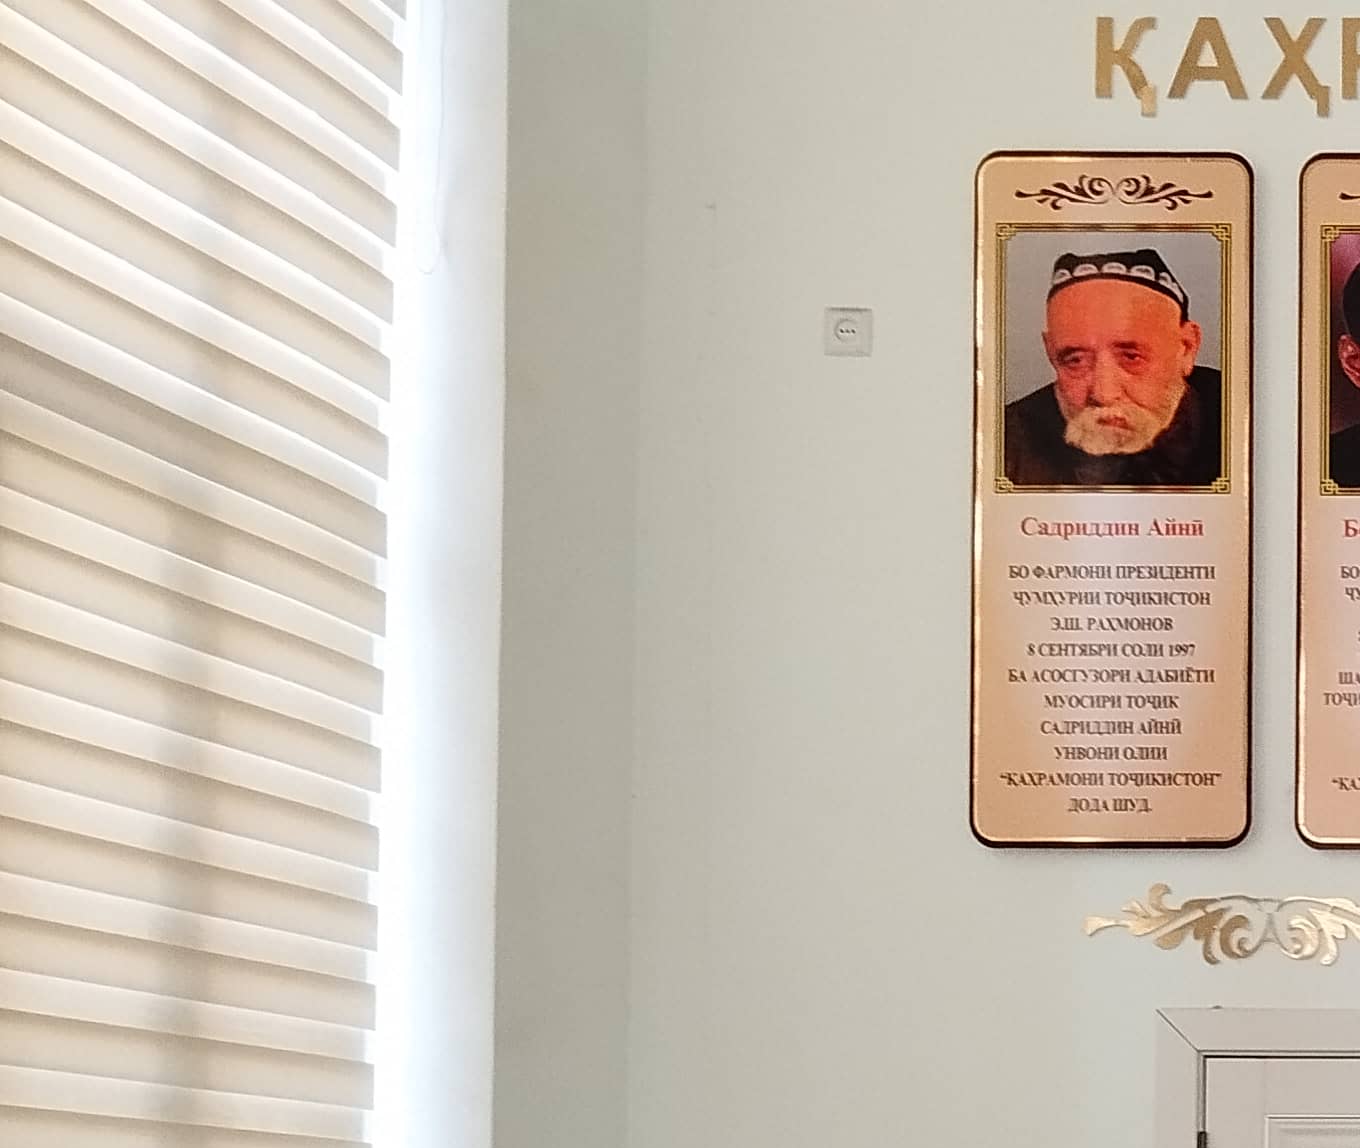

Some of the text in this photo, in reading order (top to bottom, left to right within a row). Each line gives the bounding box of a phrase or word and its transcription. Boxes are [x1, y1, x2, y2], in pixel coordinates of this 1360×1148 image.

[1020, 516, 1140, 541] Садриддин
[1008, 565, 1216, 581] БО ФАРМОНИ ПРЕЗИДЕНТИ
[1340, 566, 1360, 580] БО
[1027, 643, 1196, 657] 8 СЕНТЯБРИ СОЛИ 1997
[1008, 667, 1215, 684] БА АСОСГУЗОРИ АДАБИЁТИ
[1044, 695, 1122, 709] МУОСИРИ
[1040, 720, 1134, 736] САДРИДДИН
[1054, 746, 1168, 761] УНВОНИ ОЛИИ
